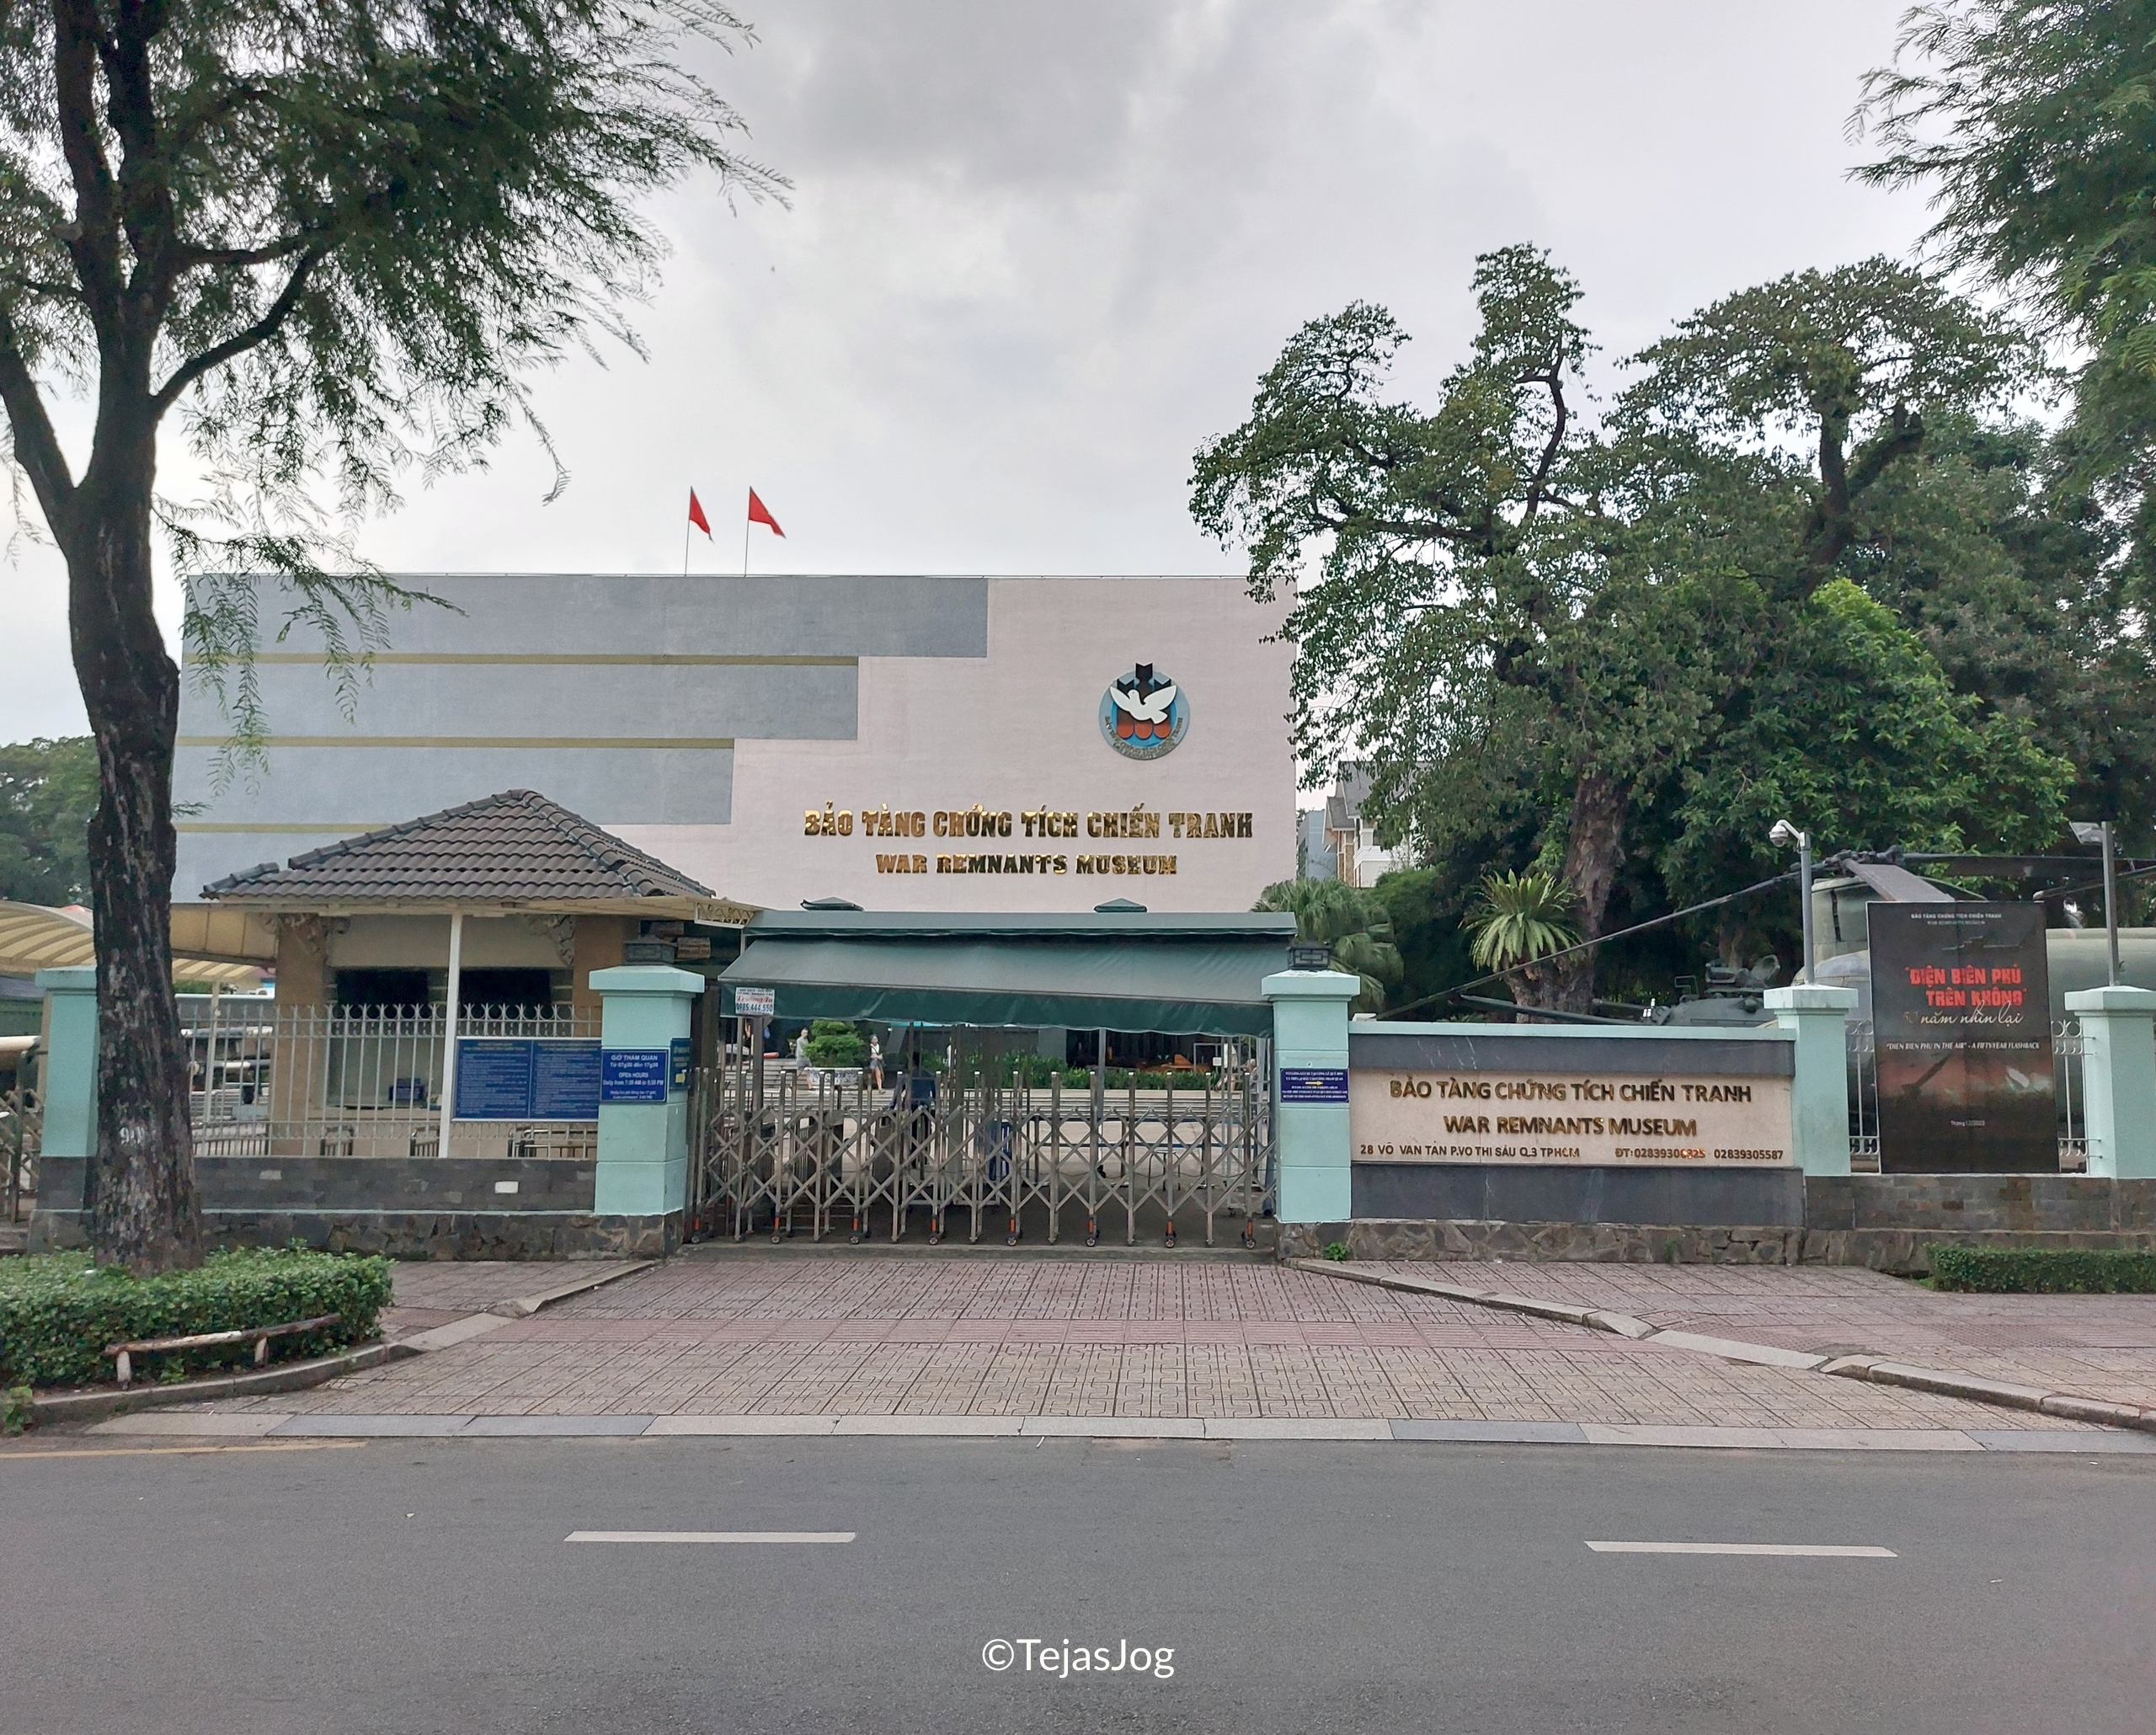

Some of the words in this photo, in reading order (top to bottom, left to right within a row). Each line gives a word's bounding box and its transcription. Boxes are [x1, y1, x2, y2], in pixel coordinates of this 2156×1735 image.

[804, 800, 852, 836] BẢO
[862, 803, 926, 837] TÀNG
[933, 803, 1012, 837] CHỨNG
[1021, 804, 1079, 838] TÍCH
[1087, 803, 1161, 838] CHIẾN
[1168, 811, 1252, 838] TRANH
[876, 854, 927, 873] WAR
[936, 854, 1067, 874] REMNANTS
[1075, 854, 1177, 874] MUSEUM
[1951, 964, 1987, 985] BIÊN
[1925, 986, 1966, 1006] TRÊN
[1921, 1011, 1958, 1024] năm
[1960, 1000, 1998, 1024] nhìn
[1998, 1001, 2024, 1028] lại
[1390, 1075, 1432, 1098] BẢO
[1436, 1077, 1491, 1099] TÀNG
[1495, 1078, 1566, 1100] CHỨNG
[1571, 1079, 1614, 1101] TÍCH
[1620, 1079, 1675, 1102] CHIẾN
[1681, 1084, 1752, 1102] TRANH
[1444, 1115, 1491, 1134] WAR
[1497, 1116, 1604, 1135] REMNANTS
[1609, 1118, 1697, 1136] MUSEUM
[1360, 1144, 1374, 1155] 28
[1495, 1144, 1516, 1157] SÁU
[1519, 1147, 1537, 1158] Q.3
[1540, 1147, 1580, 1158] TPHCM
[1714, 1149, 1784, 1160] 02839305587
